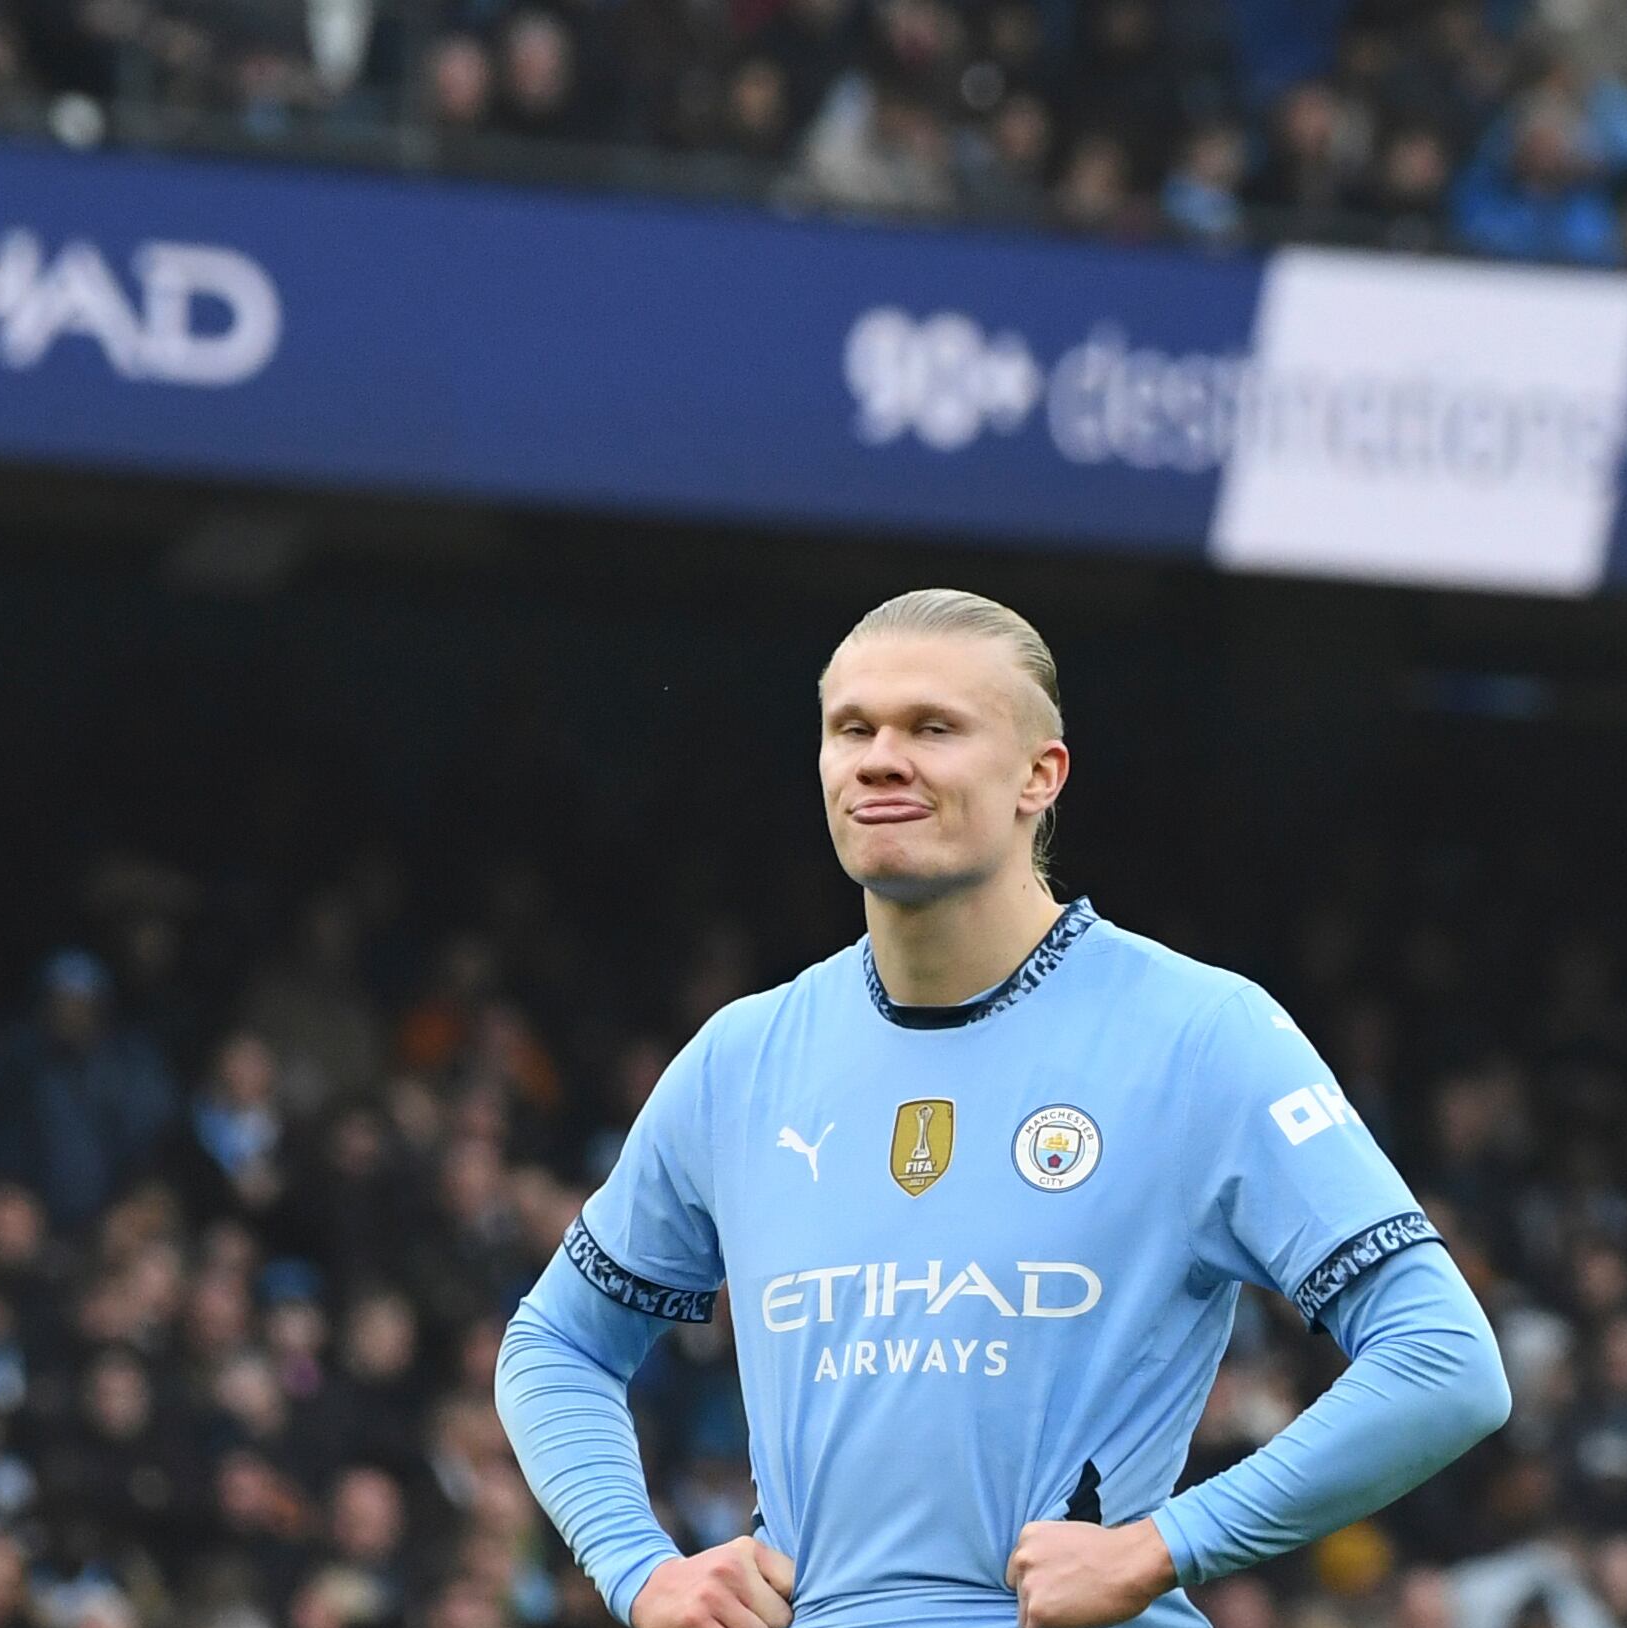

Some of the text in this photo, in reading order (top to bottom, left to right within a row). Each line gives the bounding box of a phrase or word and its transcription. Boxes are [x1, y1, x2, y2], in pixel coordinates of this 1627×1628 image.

[1025, 1111, 1094, 1140] MANCHESTER
[905, 1160, 934, 1174] FIFA
[1039, 1176, 1064, 1186] CITY
[762, 1260, 1103, 1333] ETIHAD
[814, 1338, 1009, 1382] AIRWAYS
